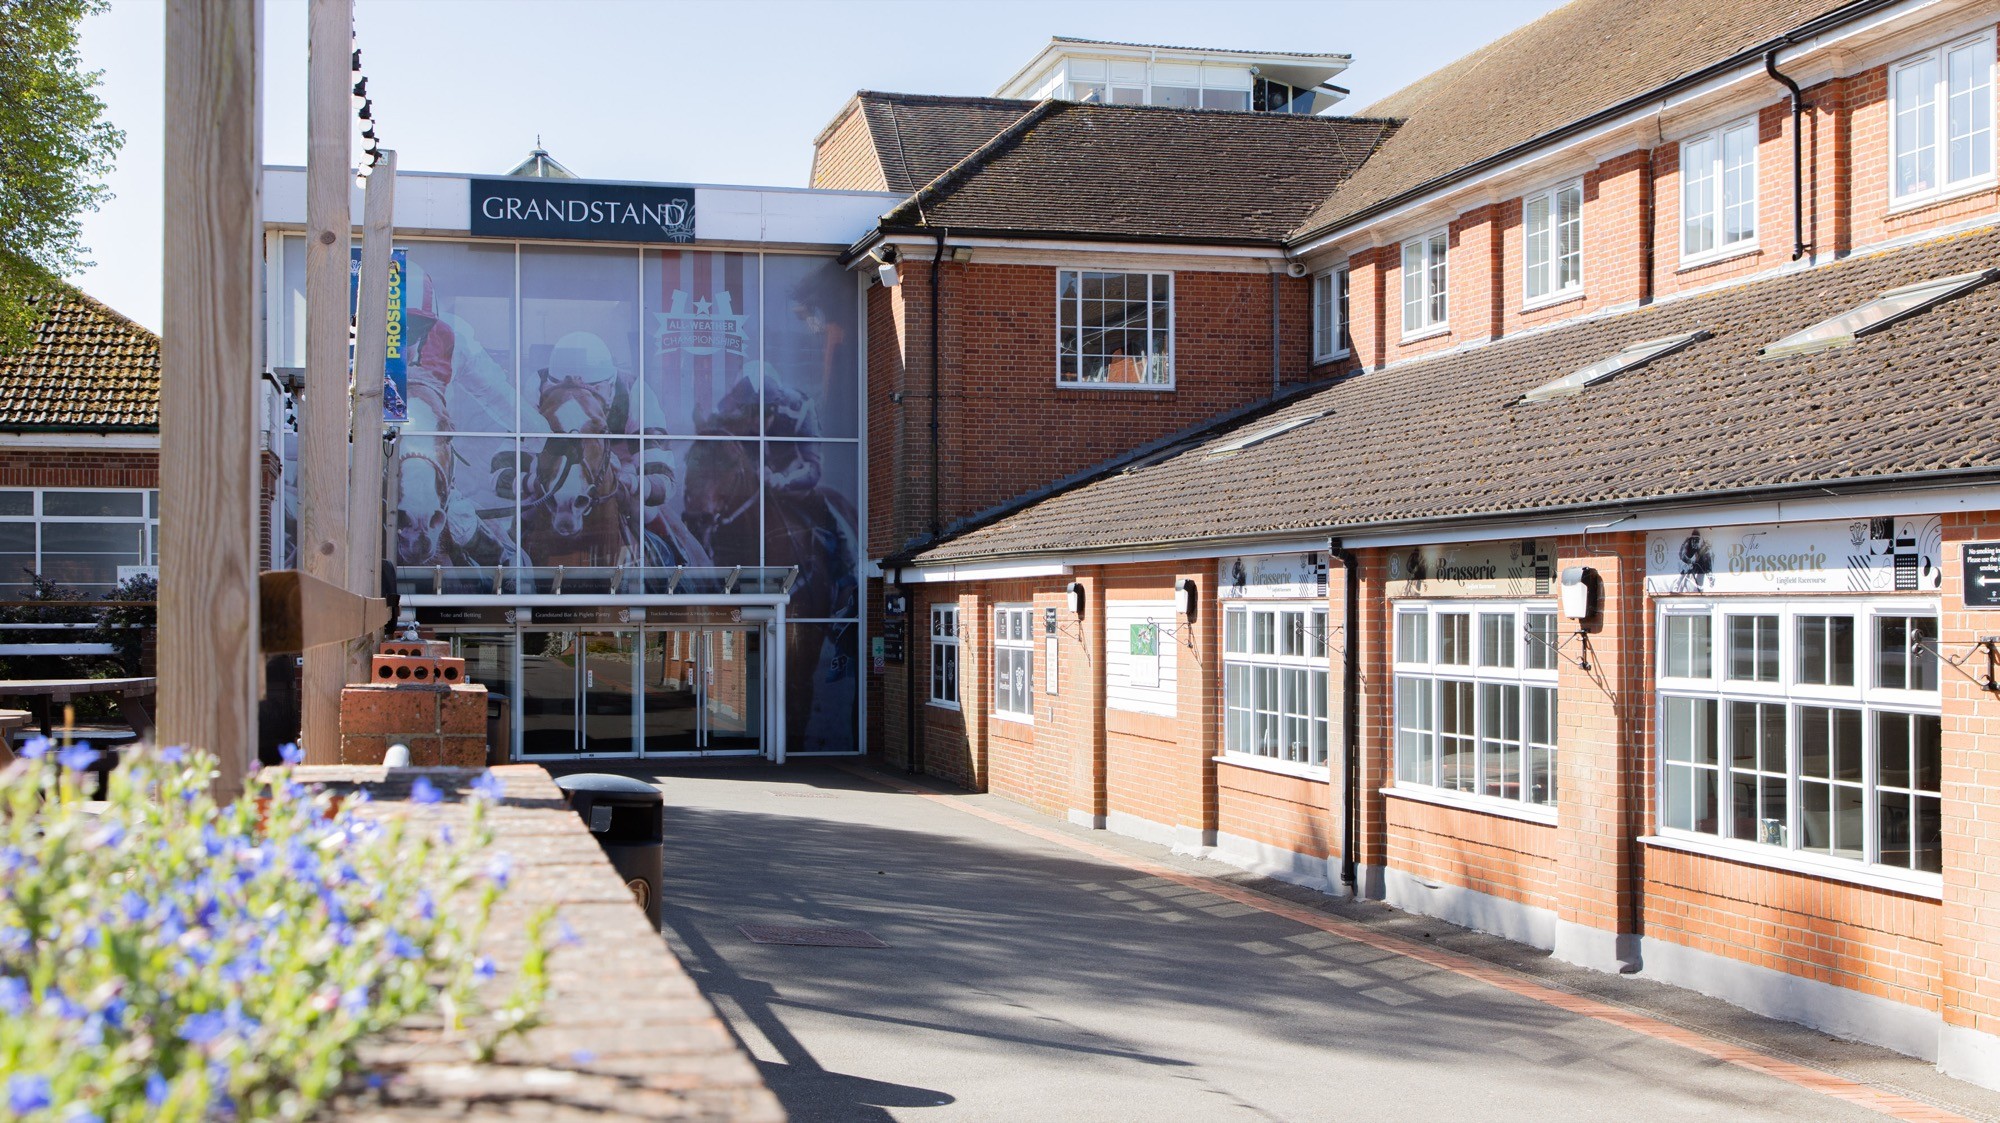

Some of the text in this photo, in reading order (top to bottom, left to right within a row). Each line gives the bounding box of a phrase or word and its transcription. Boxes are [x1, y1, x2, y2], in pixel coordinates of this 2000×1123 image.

[482, 196, 685, 226] GRANDSTAND
[669, 321, 734, 331] ALL-WEATHER
[662, 335, 741, 349] CHAMPIONSHIPS
[1436, 557, 1497, 588] Brasserie
[1727, 543, 1827, 581] Brasserie
[1252, 566, 1292, 591] Brasserie
